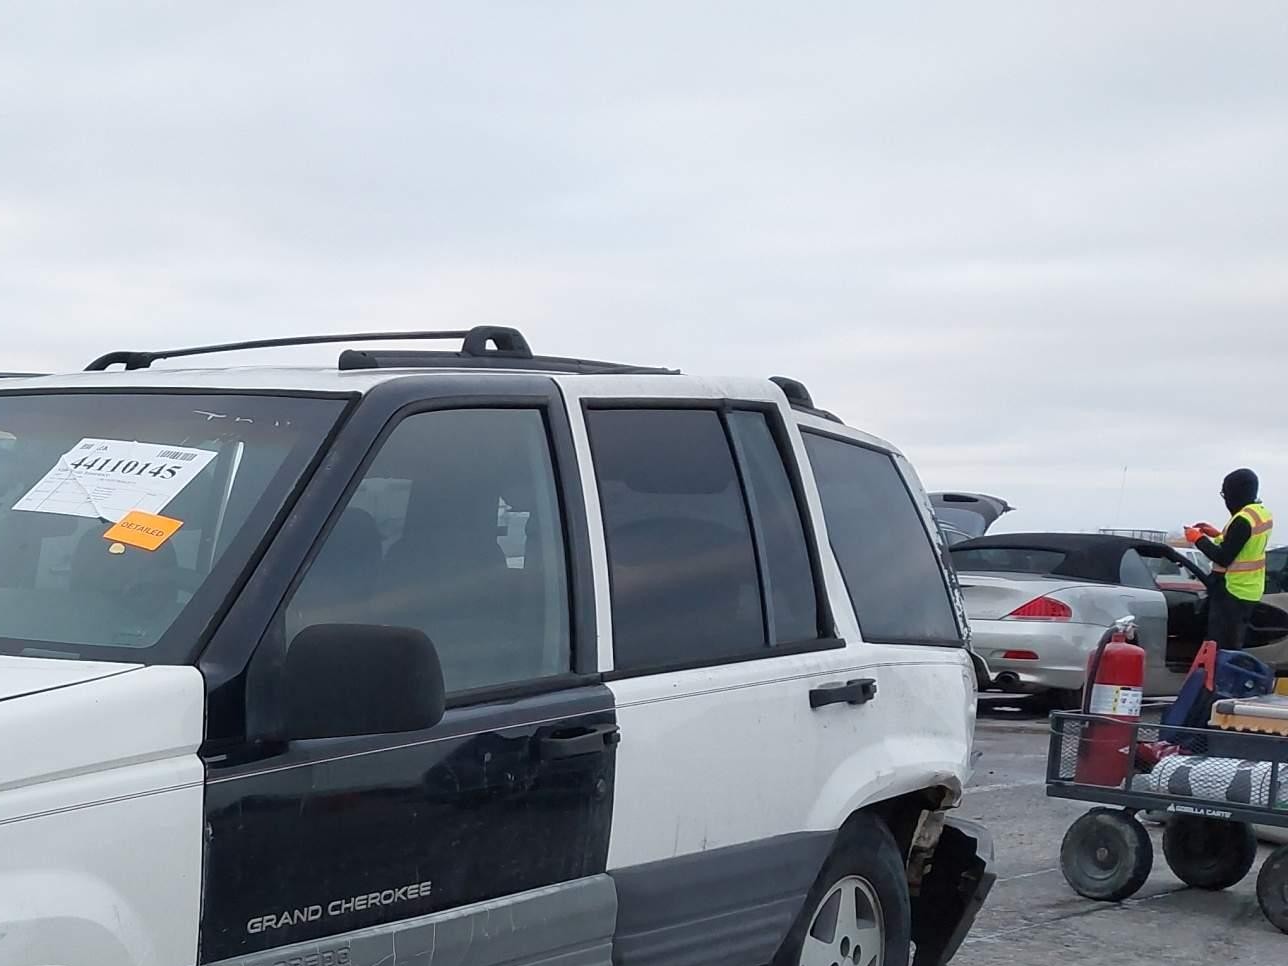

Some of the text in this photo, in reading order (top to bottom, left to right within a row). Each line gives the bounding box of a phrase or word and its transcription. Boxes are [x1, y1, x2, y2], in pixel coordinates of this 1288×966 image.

[70, 455, 182, 480] 44110145
[120, 521, 165, 538] DETAILED
[247, 880, 432, 934] GRAND CHEROKEE
